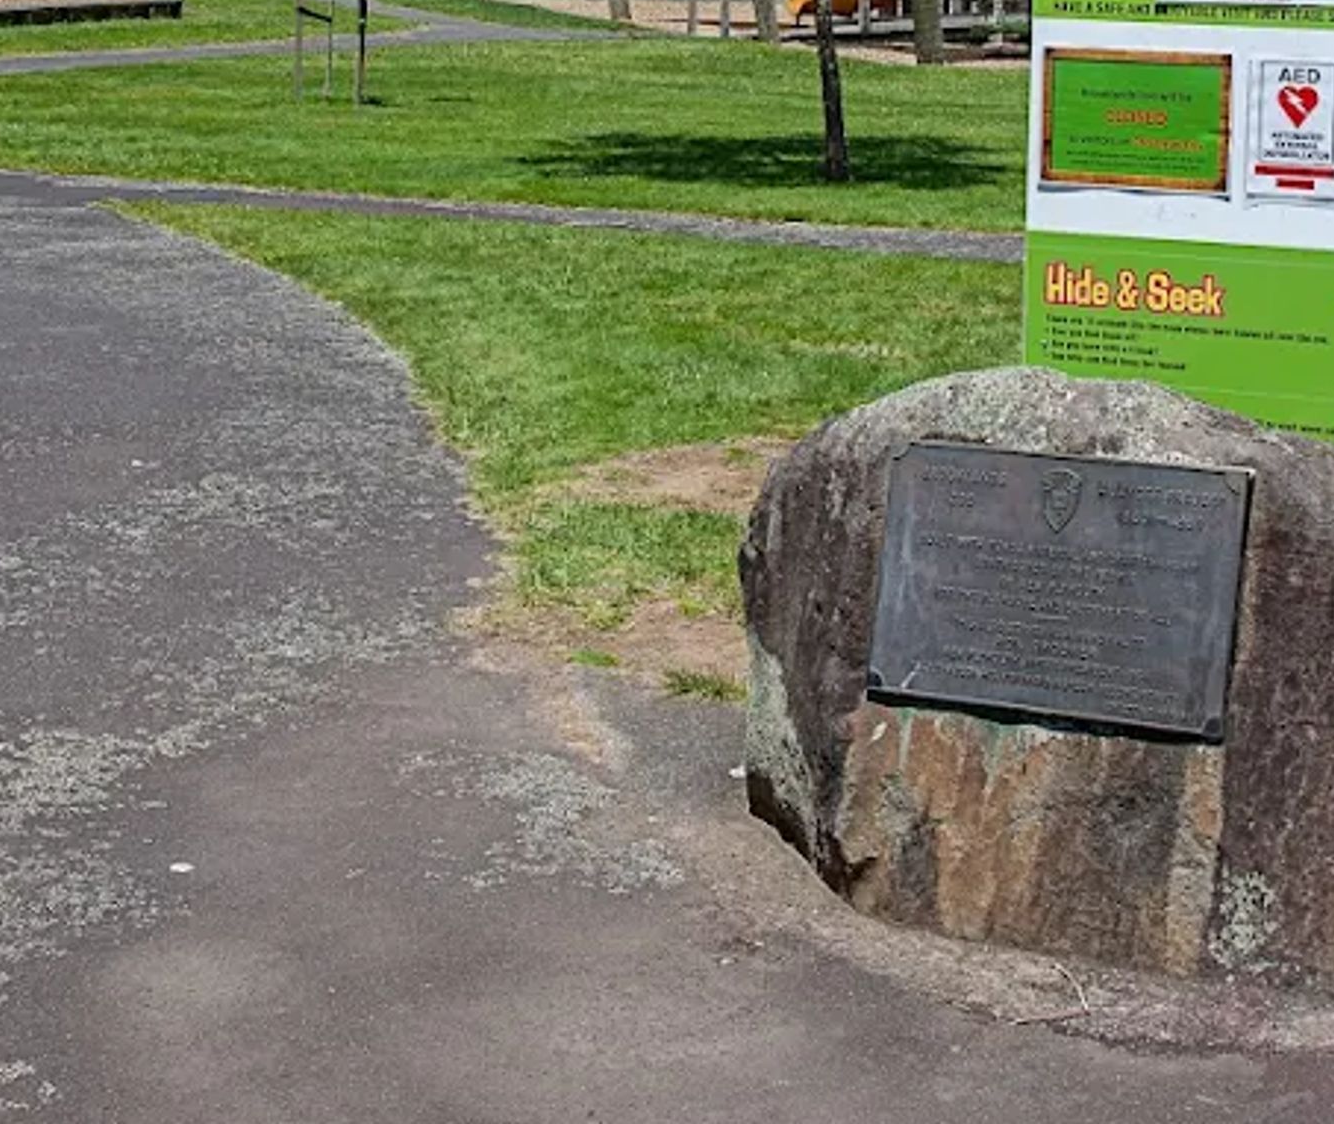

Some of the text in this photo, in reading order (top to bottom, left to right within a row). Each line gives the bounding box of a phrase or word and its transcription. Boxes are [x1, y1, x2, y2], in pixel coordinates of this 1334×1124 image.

[1278, 67, 1321, 84] AED
[1045, 260, 1224, 317] Hide & Seek
